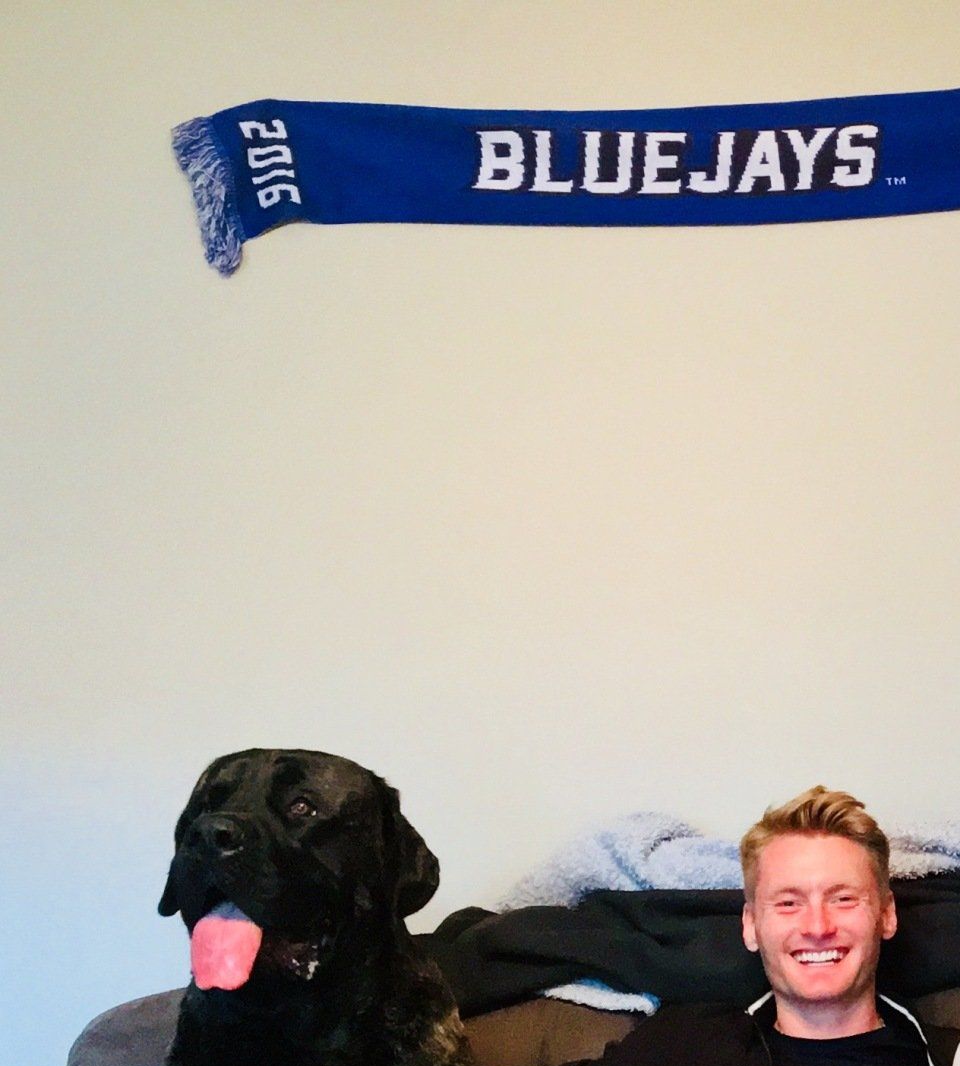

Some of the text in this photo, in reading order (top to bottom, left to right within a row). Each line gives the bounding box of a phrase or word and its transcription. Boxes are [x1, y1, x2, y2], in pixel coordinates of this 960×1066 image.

[238, 119, 302, 209] 2016
[472, 124, 907, 194] BLUEJAYS TM
